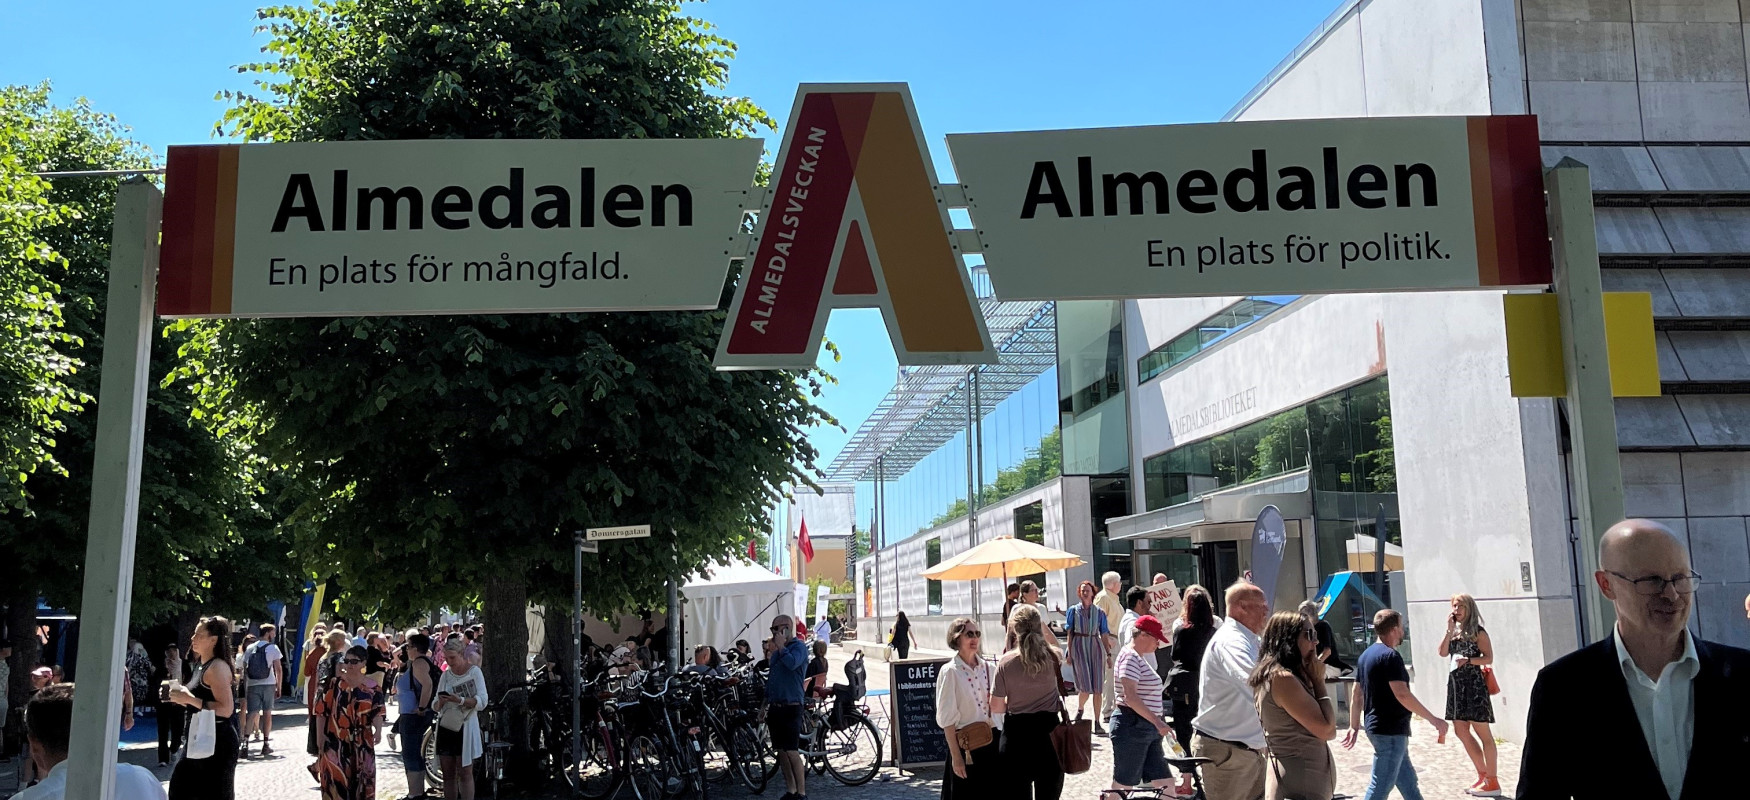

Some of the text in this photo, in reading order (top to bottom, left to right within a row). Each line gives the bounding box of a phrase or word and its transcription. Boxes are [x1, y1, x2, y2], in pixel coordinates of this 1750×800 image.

[270, 167, 693, 233] Almedalen
[1019, 146, 1439, 219] Almedalen
[750, 126, 827, 335] ALMEDALSVECKAN
[268, 251, 630, 292] En plats för mångfald.
[1147, 231, 1451, 273] En plats för politik.
[1168, 386, 1257, 441] ALMEDALSBIBLIOTEKET
[591, 528, 646, 538] Donnersgatan
[900, 682, 931, 690] bibliotekets
[908, 664, 935, 679] CAFÉ
